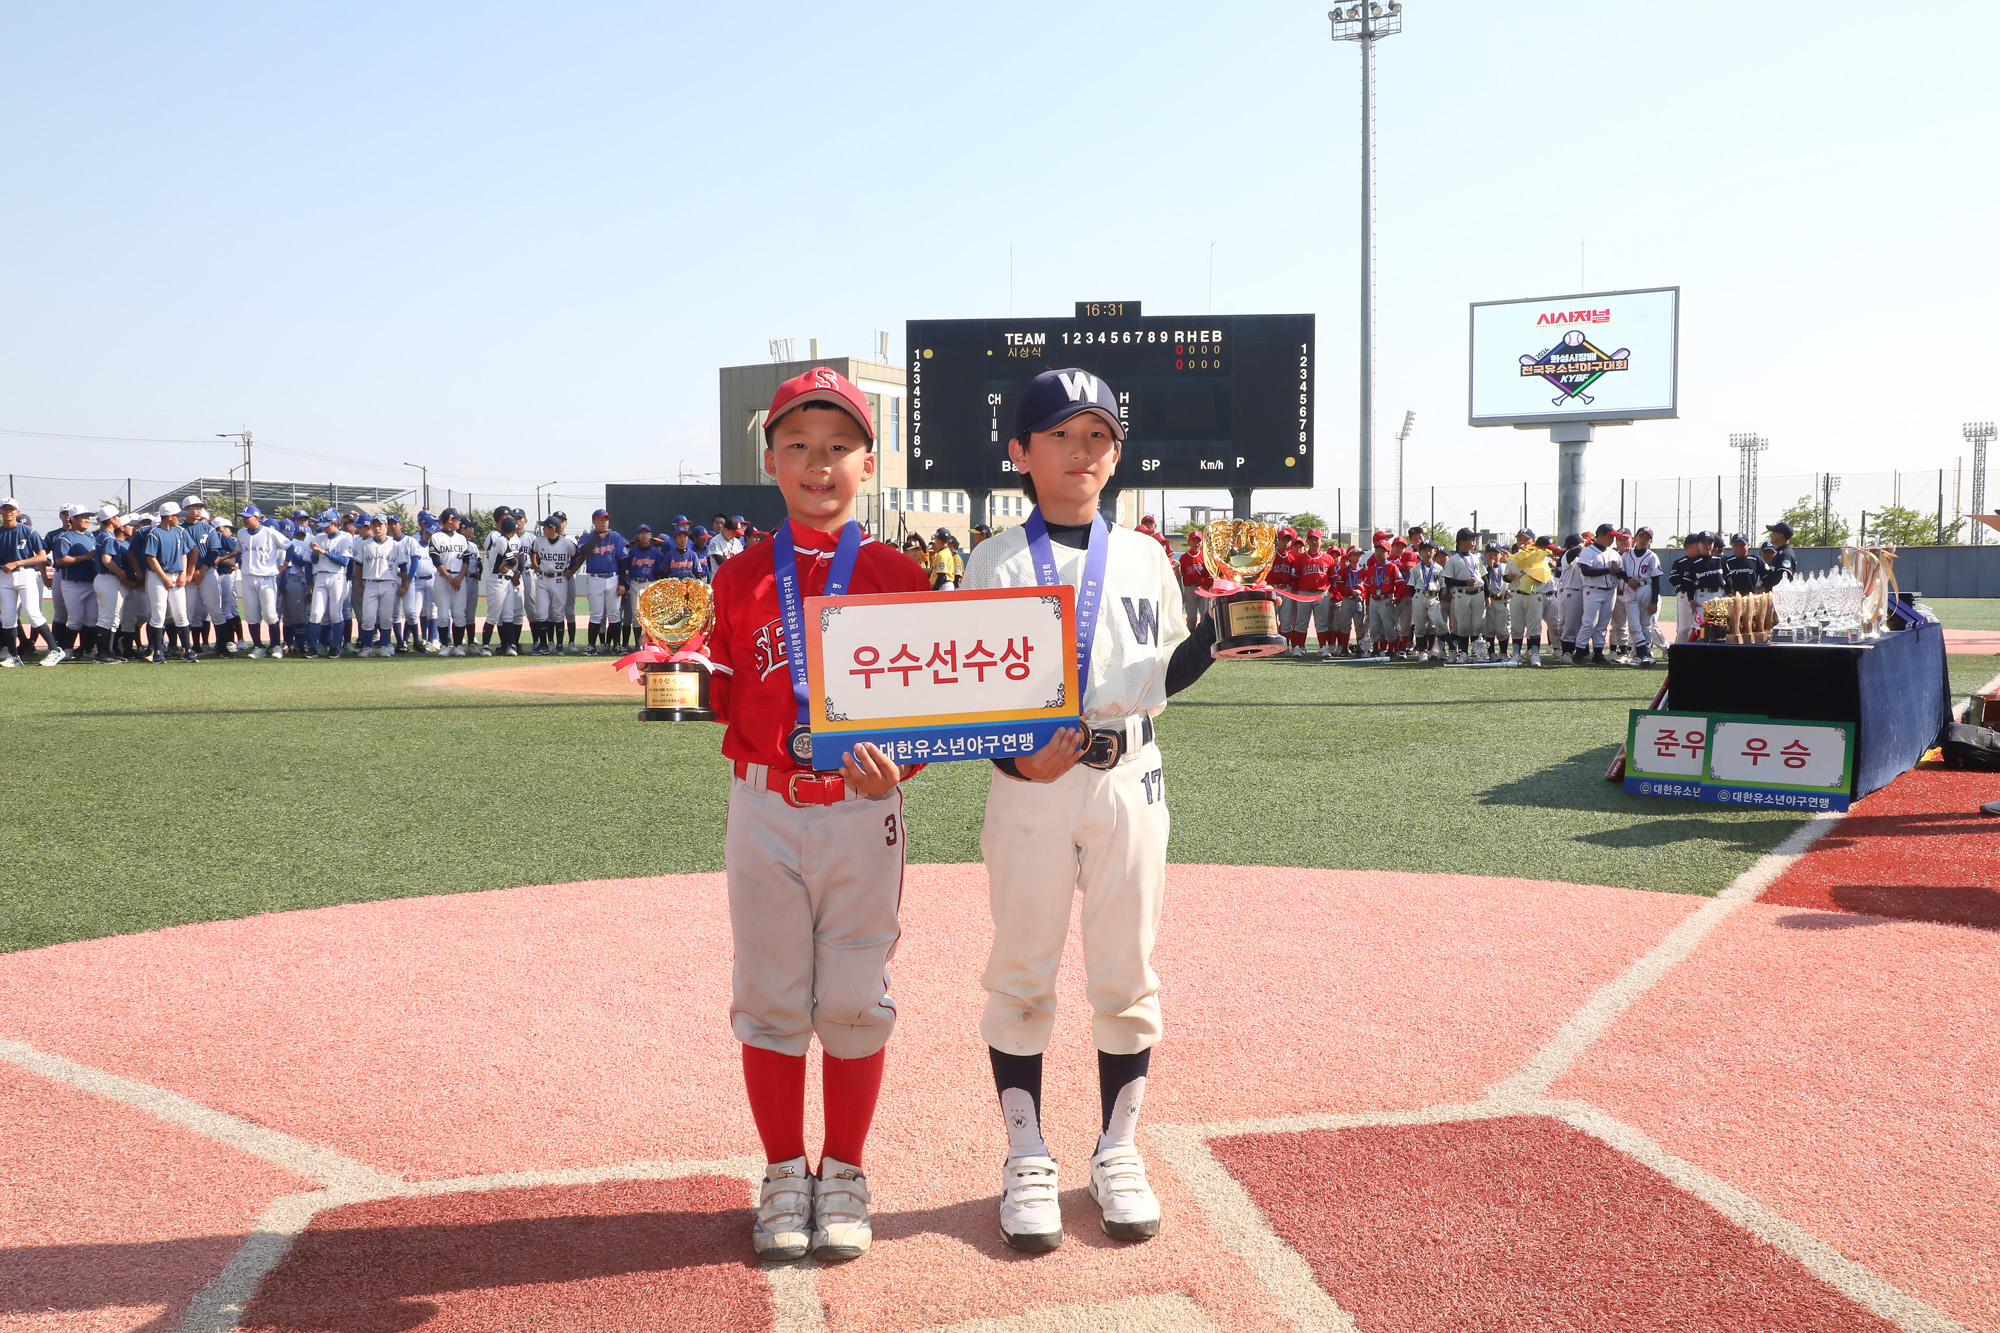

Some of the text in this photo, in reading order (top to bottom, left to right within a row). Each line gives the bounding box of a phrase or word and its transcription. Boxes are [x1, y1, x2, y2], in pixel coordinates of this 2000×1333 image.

[1086, 304, 1123, 316] 16:31
[1536, 308, 1610, 325] 시사저널
[1005, 333, 1046, 345] TEAM
[1008, 347, 1041, 358] 시상식
[1522, 360, 1628, 375] 전국유소년야구대회
[1560, 374, 1590, 383] KYBF
[1058, 372, 1098, 404] W
[988, 394, 1001, 404] CH
[925, 460, 933, 470] P
[1142, 459, 1160, 471] SP
[1200, 460, 1224, 470] Km/h
[1236, 457, 1244, 468] P
[1121, 597, 1159, 648] W
[849, 636, 1033, 689] 우수선수상
[879, 732, 1034, 761] 대한유소년야구연맹
[1141, 768, 1161, 805] 17
[1732, 792, 1829, 809] 대한유소년야구연맹
[885, 814, 897, 846] 3
